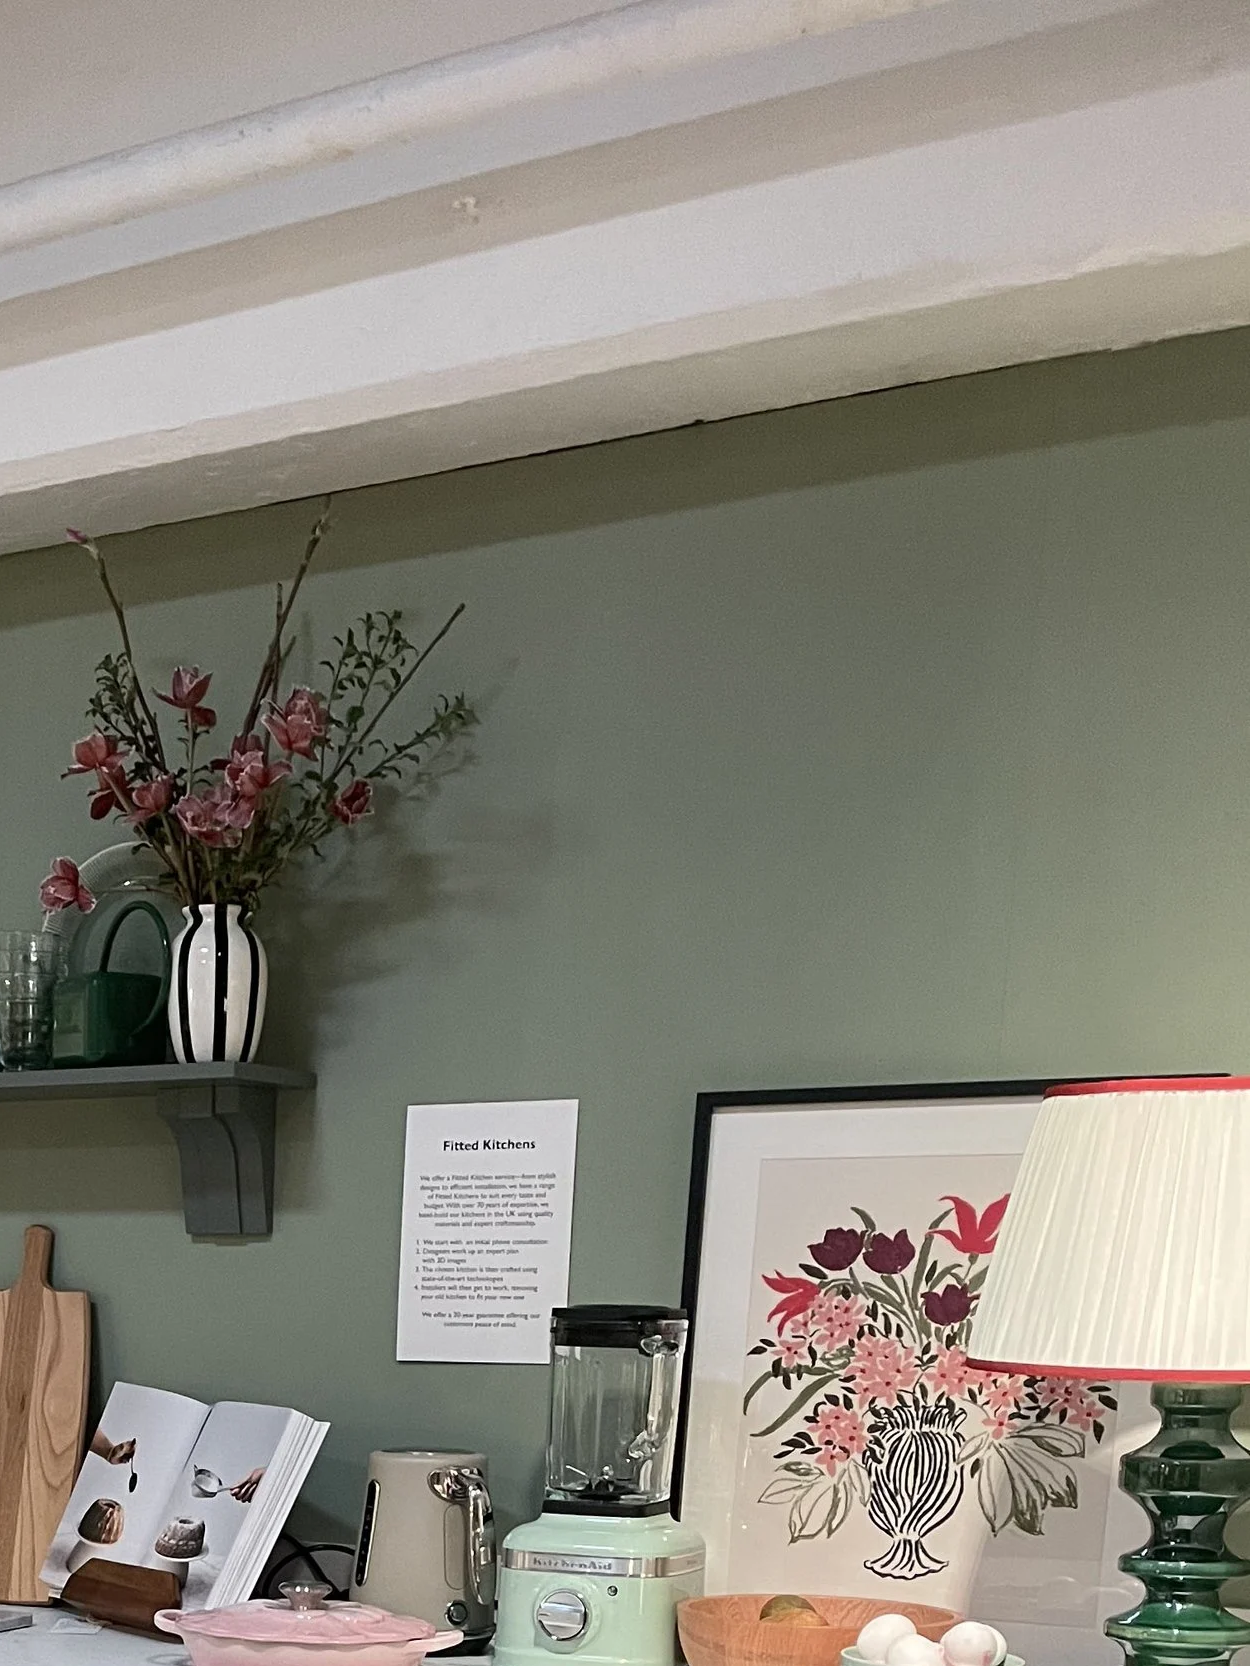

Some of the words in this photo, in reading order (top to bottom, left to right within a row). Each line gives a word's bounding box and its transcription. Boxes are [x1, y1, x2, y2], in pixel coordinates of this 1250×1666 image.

[443, 1140, 479, 1151] Fitted
[483, 1139, 536, 1150] Kitchens
[501, 1193, 517, 1201] every
[485, 1202, 500, 1210] years
[461, 1210, 485, 1218] kitchens
[517, 1210, 532, 1219] using
[474, 1220, 493, 1229] expert
[492, 1238, 510, 1247] phone
[468, 1248, 475, 1256] up
[486, 1247, 505, 1256] expert
[522, 1265, 538, 1275] using
[473, 1284, 483, 1293] get
[421, 1294, 433, 1302] your
[484, 1294, 497, 1302] your
[506, 1311, 528, 1321] offering
[475, 1321, 491, 1330] peace
[533, 1558, 612, 1570] KitchenAid
